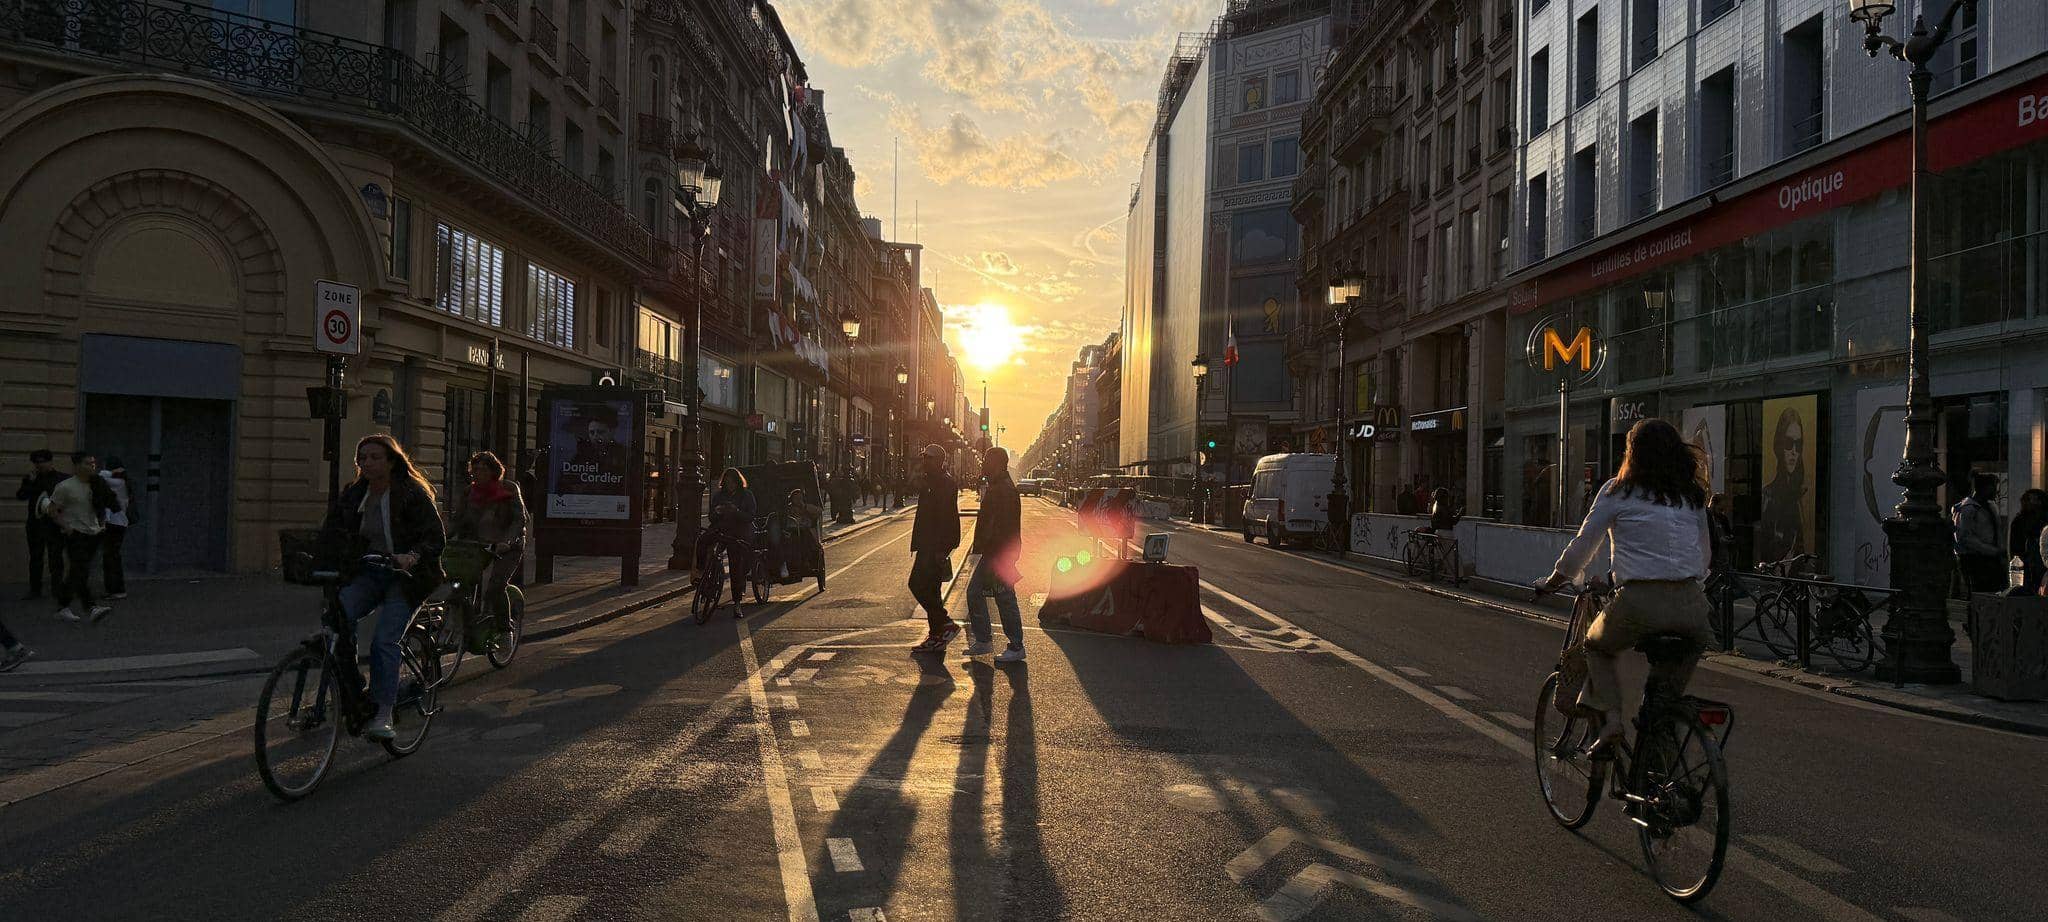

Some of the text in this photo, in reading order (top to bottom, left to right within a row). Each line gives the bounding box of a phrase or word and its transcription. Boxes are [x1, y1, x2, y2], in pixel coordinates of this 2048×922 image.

[1778, 168, 1844, 211] Optique
[1591, 226, 1692, 278] Lentilles de contact
[324, 290, 352, 304] ZONE
[330, 319, 346, 334] 30
[1543, 325, 1593, 372] M
[1356, 424, 1375, 438] JD
[562, 462, 599, 472] Daniel
[580, 472, 624, 484] Cordier
